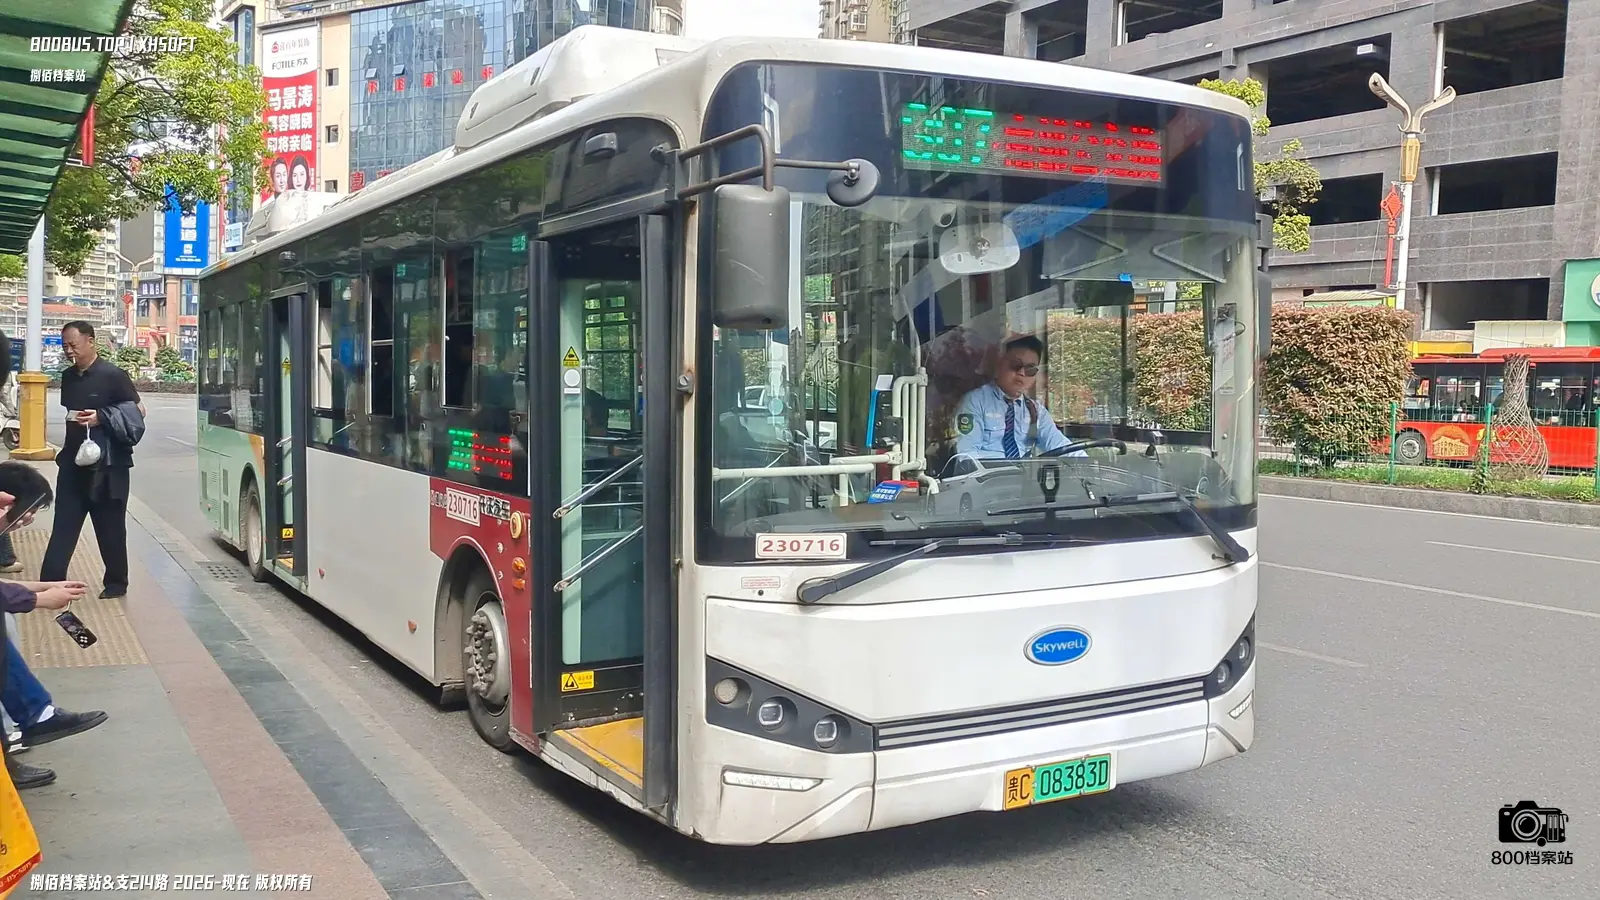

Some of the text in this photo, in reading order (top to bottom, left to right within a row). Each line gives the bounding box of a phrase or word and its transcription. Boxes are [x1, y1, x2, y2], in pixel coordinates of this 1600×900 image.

[272, 60, 295, 70] FOTILE
[268, 84, 313, 111] 马景涛
[266, 134, 313, 154] 即将亲临
[448, 493, 478, 520] 230716
[762, 539, 840, 552] 230716
[1040, 759, 1109, 797] 08383D
